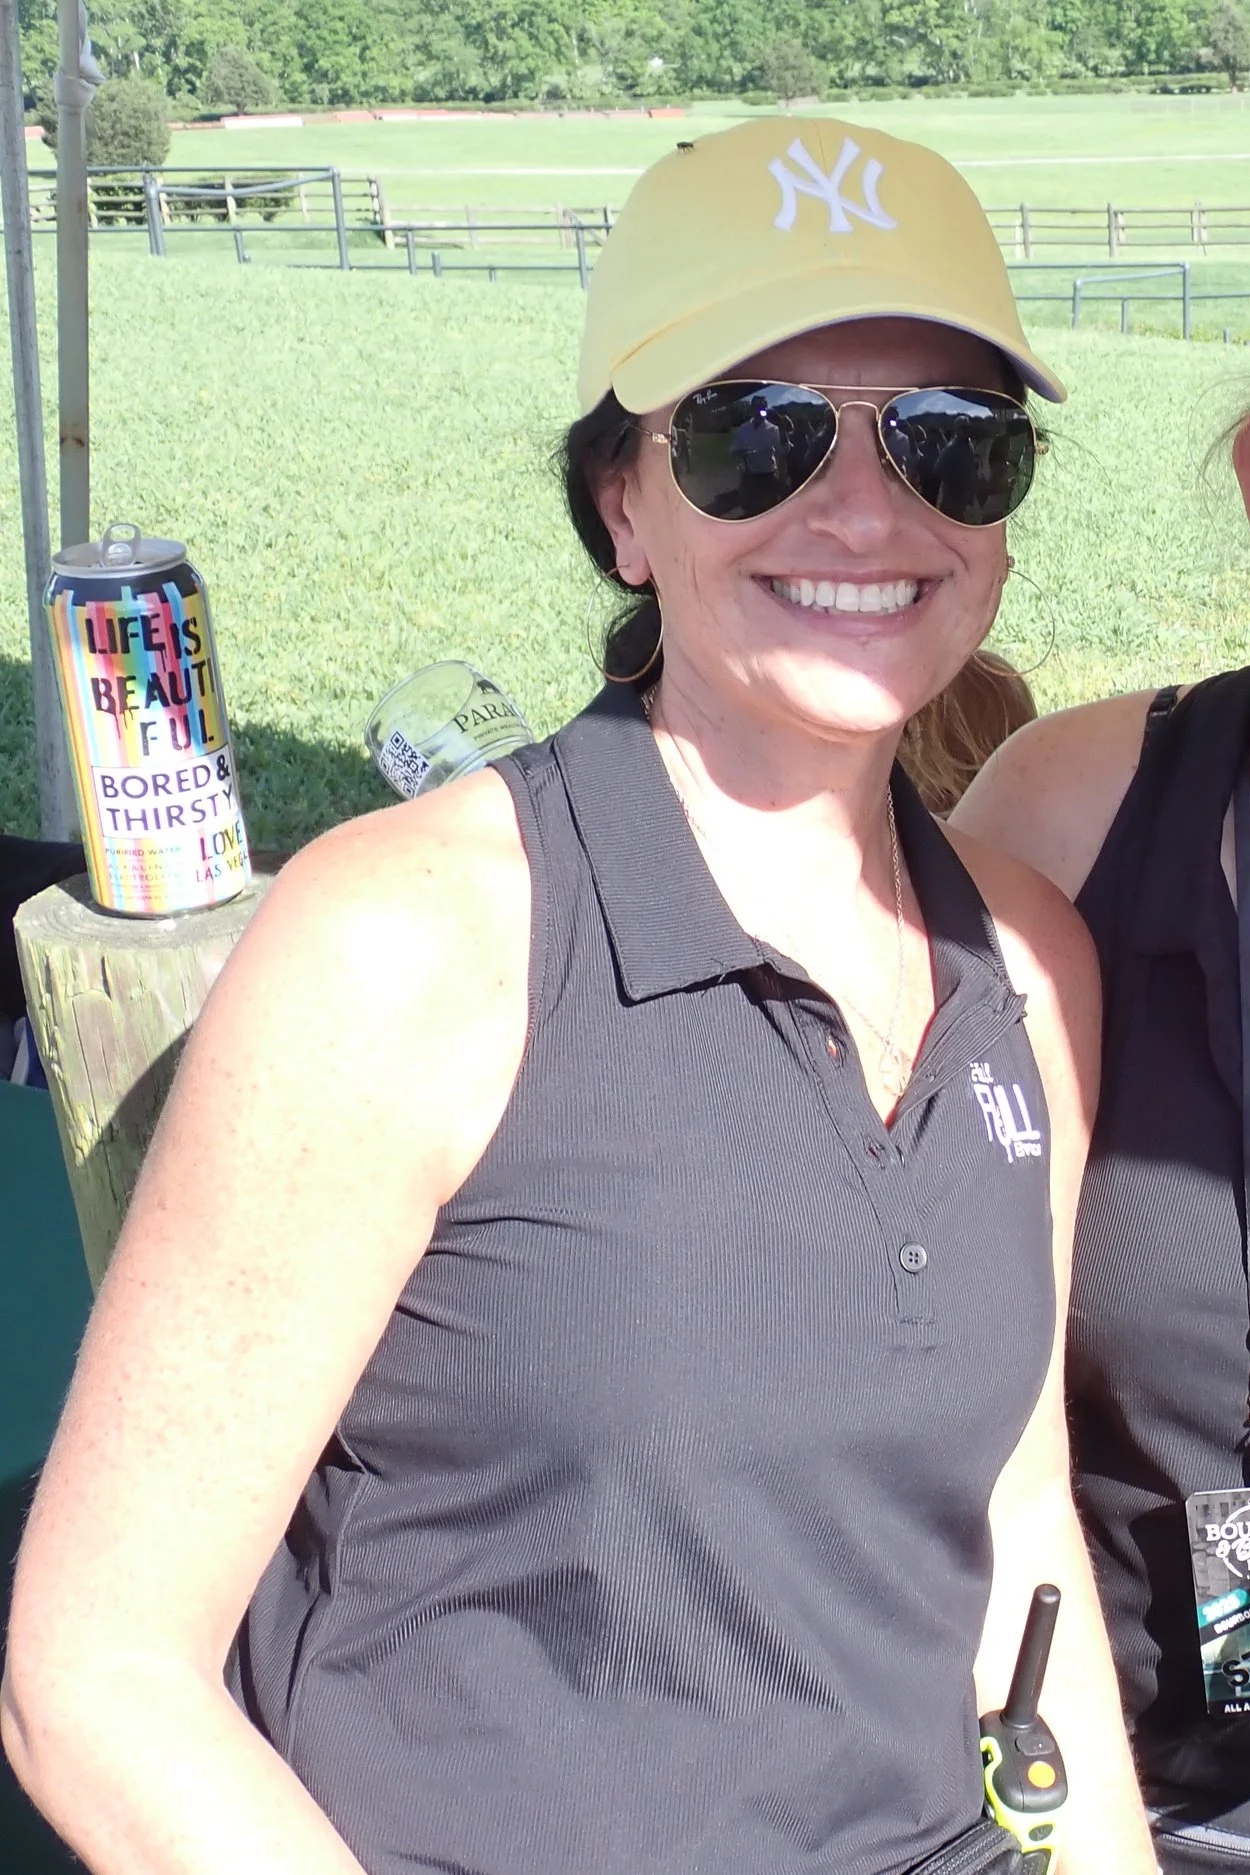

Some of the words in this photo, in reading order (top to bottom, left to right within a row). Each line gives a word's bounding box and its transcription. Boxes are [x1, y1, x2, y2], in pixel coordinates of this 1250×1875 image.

[768, 137, 898, 233] NY
[85, 612, 167, 654] LIFE
[169, 616, 202, 660] IS
[90, 657, 216, 717] BEAUTI
[139, 708, 215, 757] FUL
[100, 764, 211, 799] BORED
[216, 754, 231, 782] &
[106, 784, 233, 832] THIRSTY
[199, 820, 244, 862] LOVE
[195, 863, 223, 884] LAS
[1224, 1703, 1243, 1714] ALL
